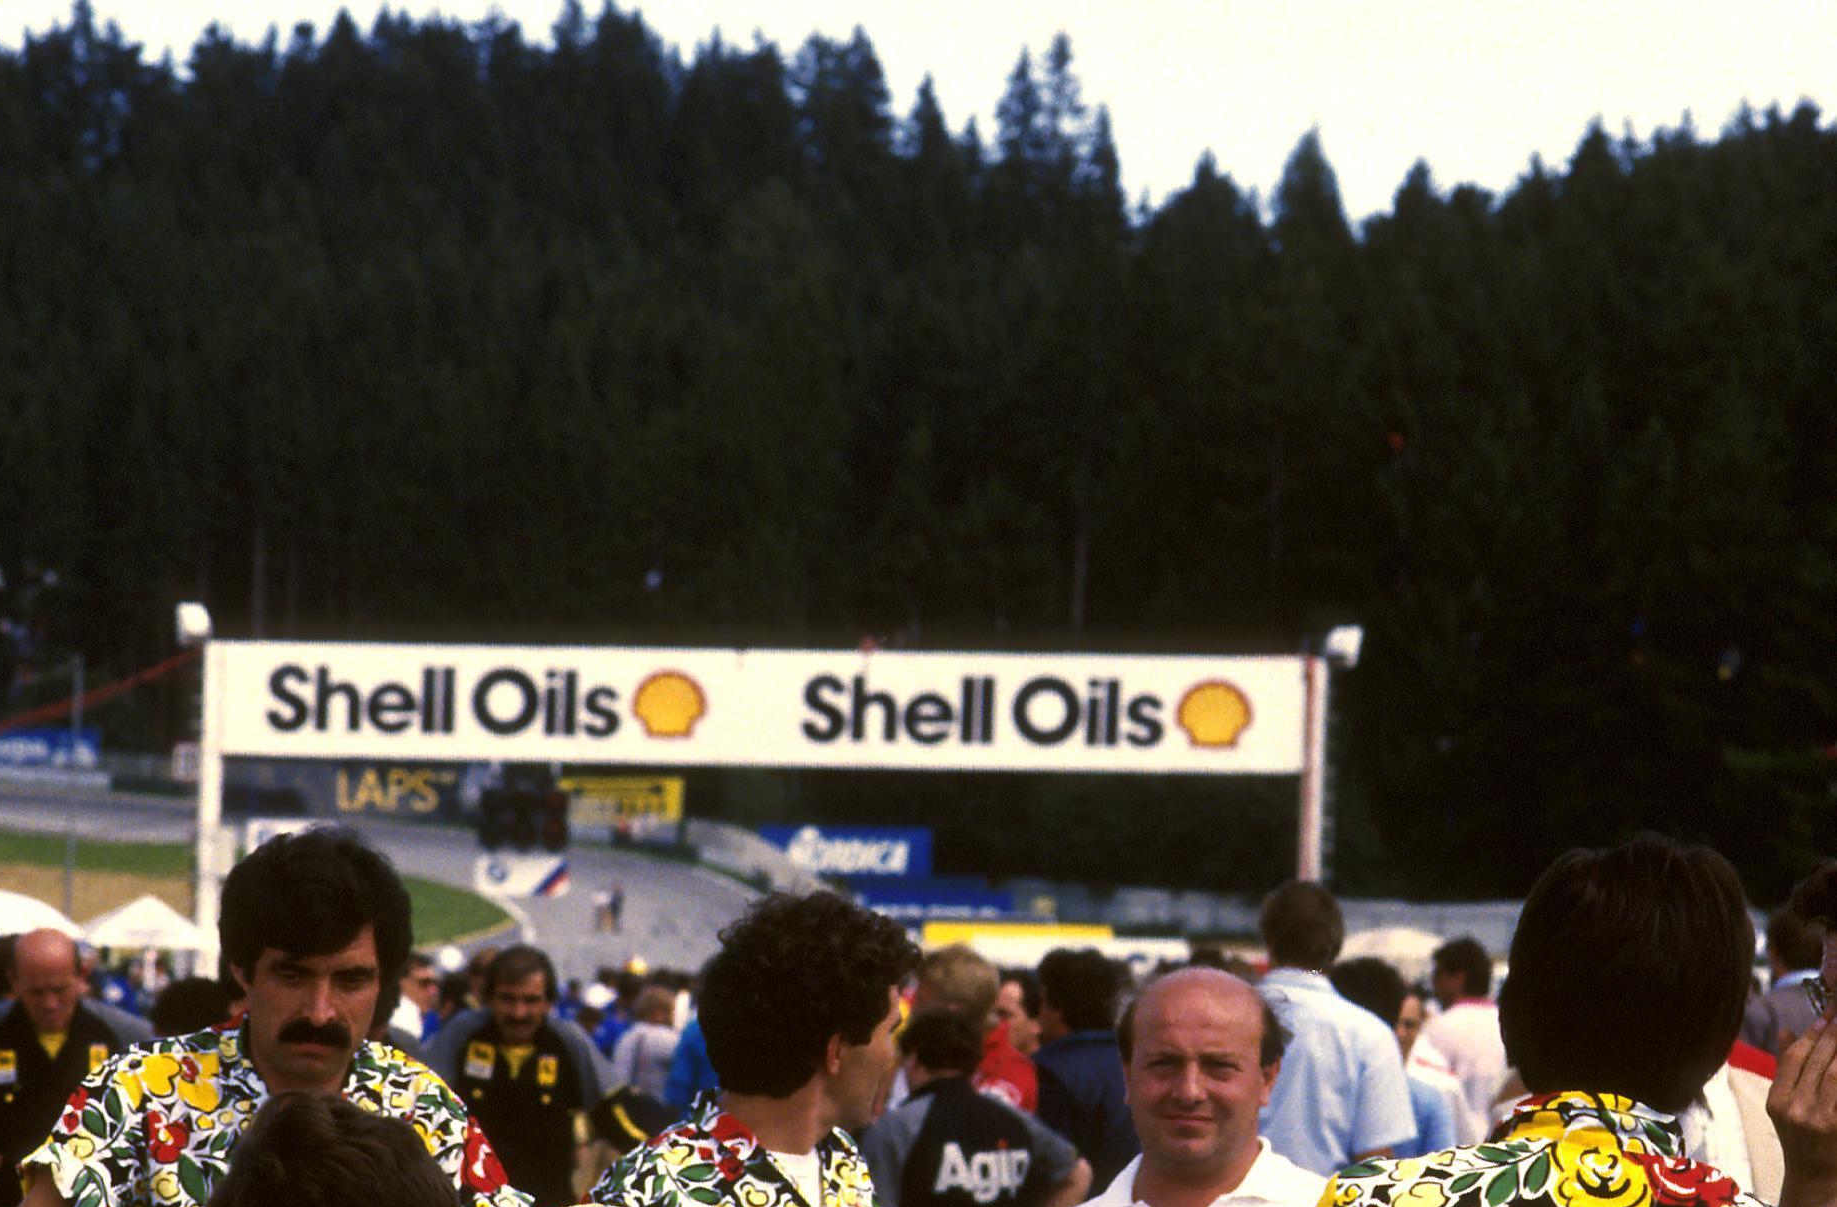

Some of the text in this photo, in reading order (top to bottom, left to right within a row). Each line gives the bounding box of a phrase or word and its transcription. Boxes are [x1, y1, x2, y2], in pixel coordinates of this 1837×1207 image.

[266, 664, 621, 738] Shell Oils
[802, 674, 1164, 748] Shell Oils
